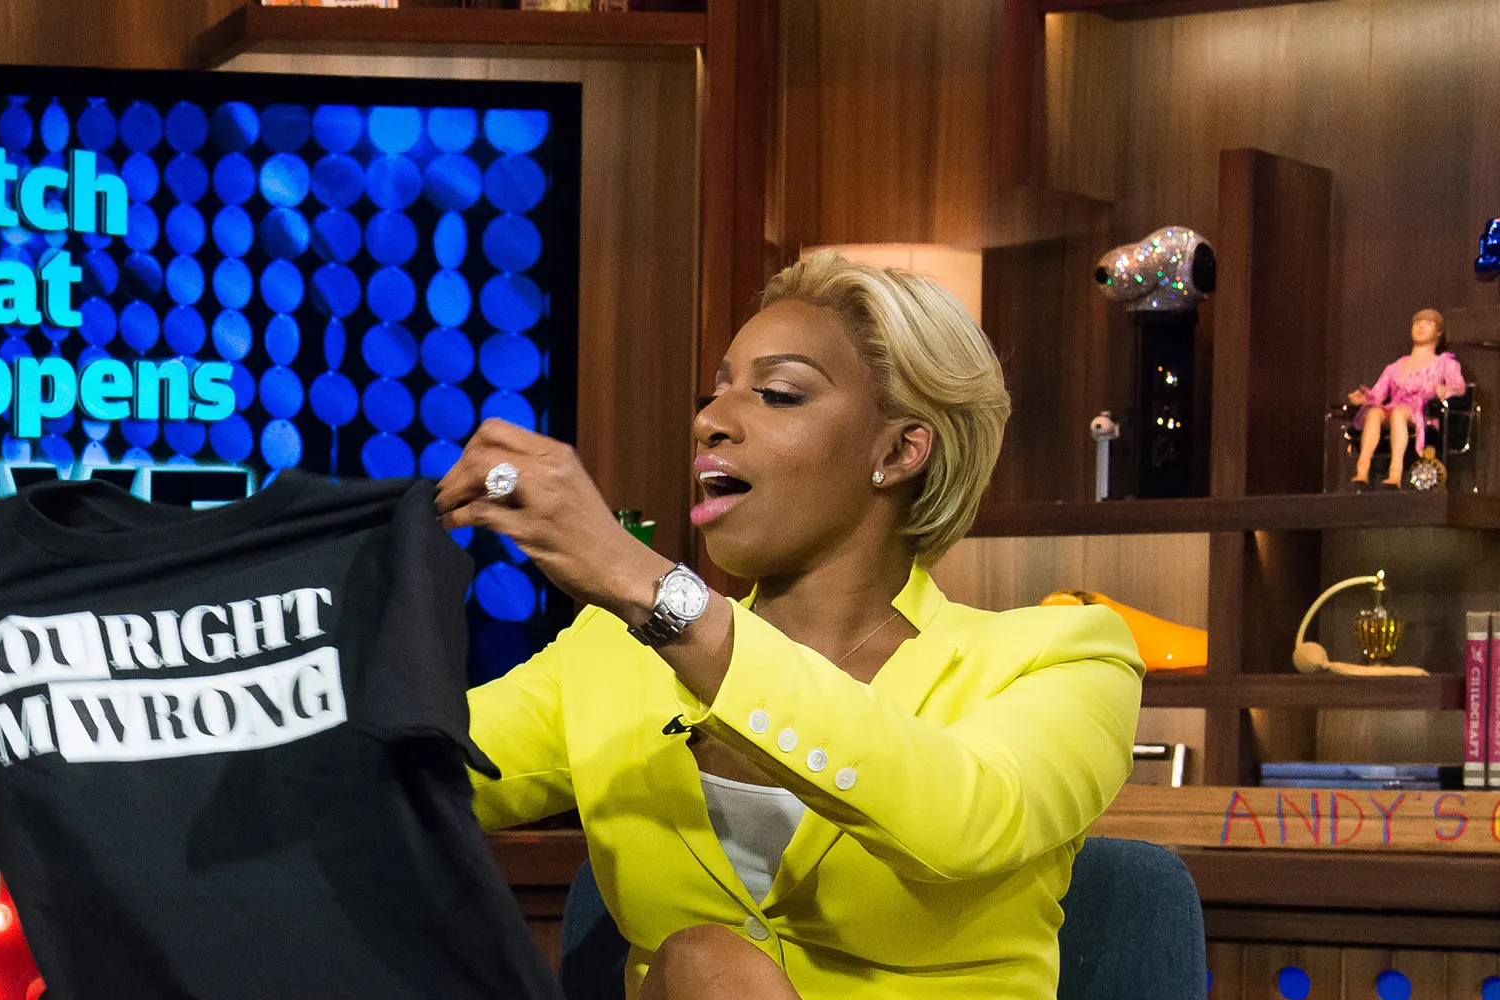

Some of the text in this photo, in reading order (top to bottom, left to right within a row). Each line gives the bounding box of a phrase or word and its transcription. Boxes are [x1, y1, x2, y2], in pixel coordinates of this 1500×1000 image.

[100, 587, 333, 671] RIGHT
[64, 663, 332, 746] WRONG
[1469, 666, 1482, 758] CHILDCRAFT
[1219, 791, 1468, 847] ANDY'S
